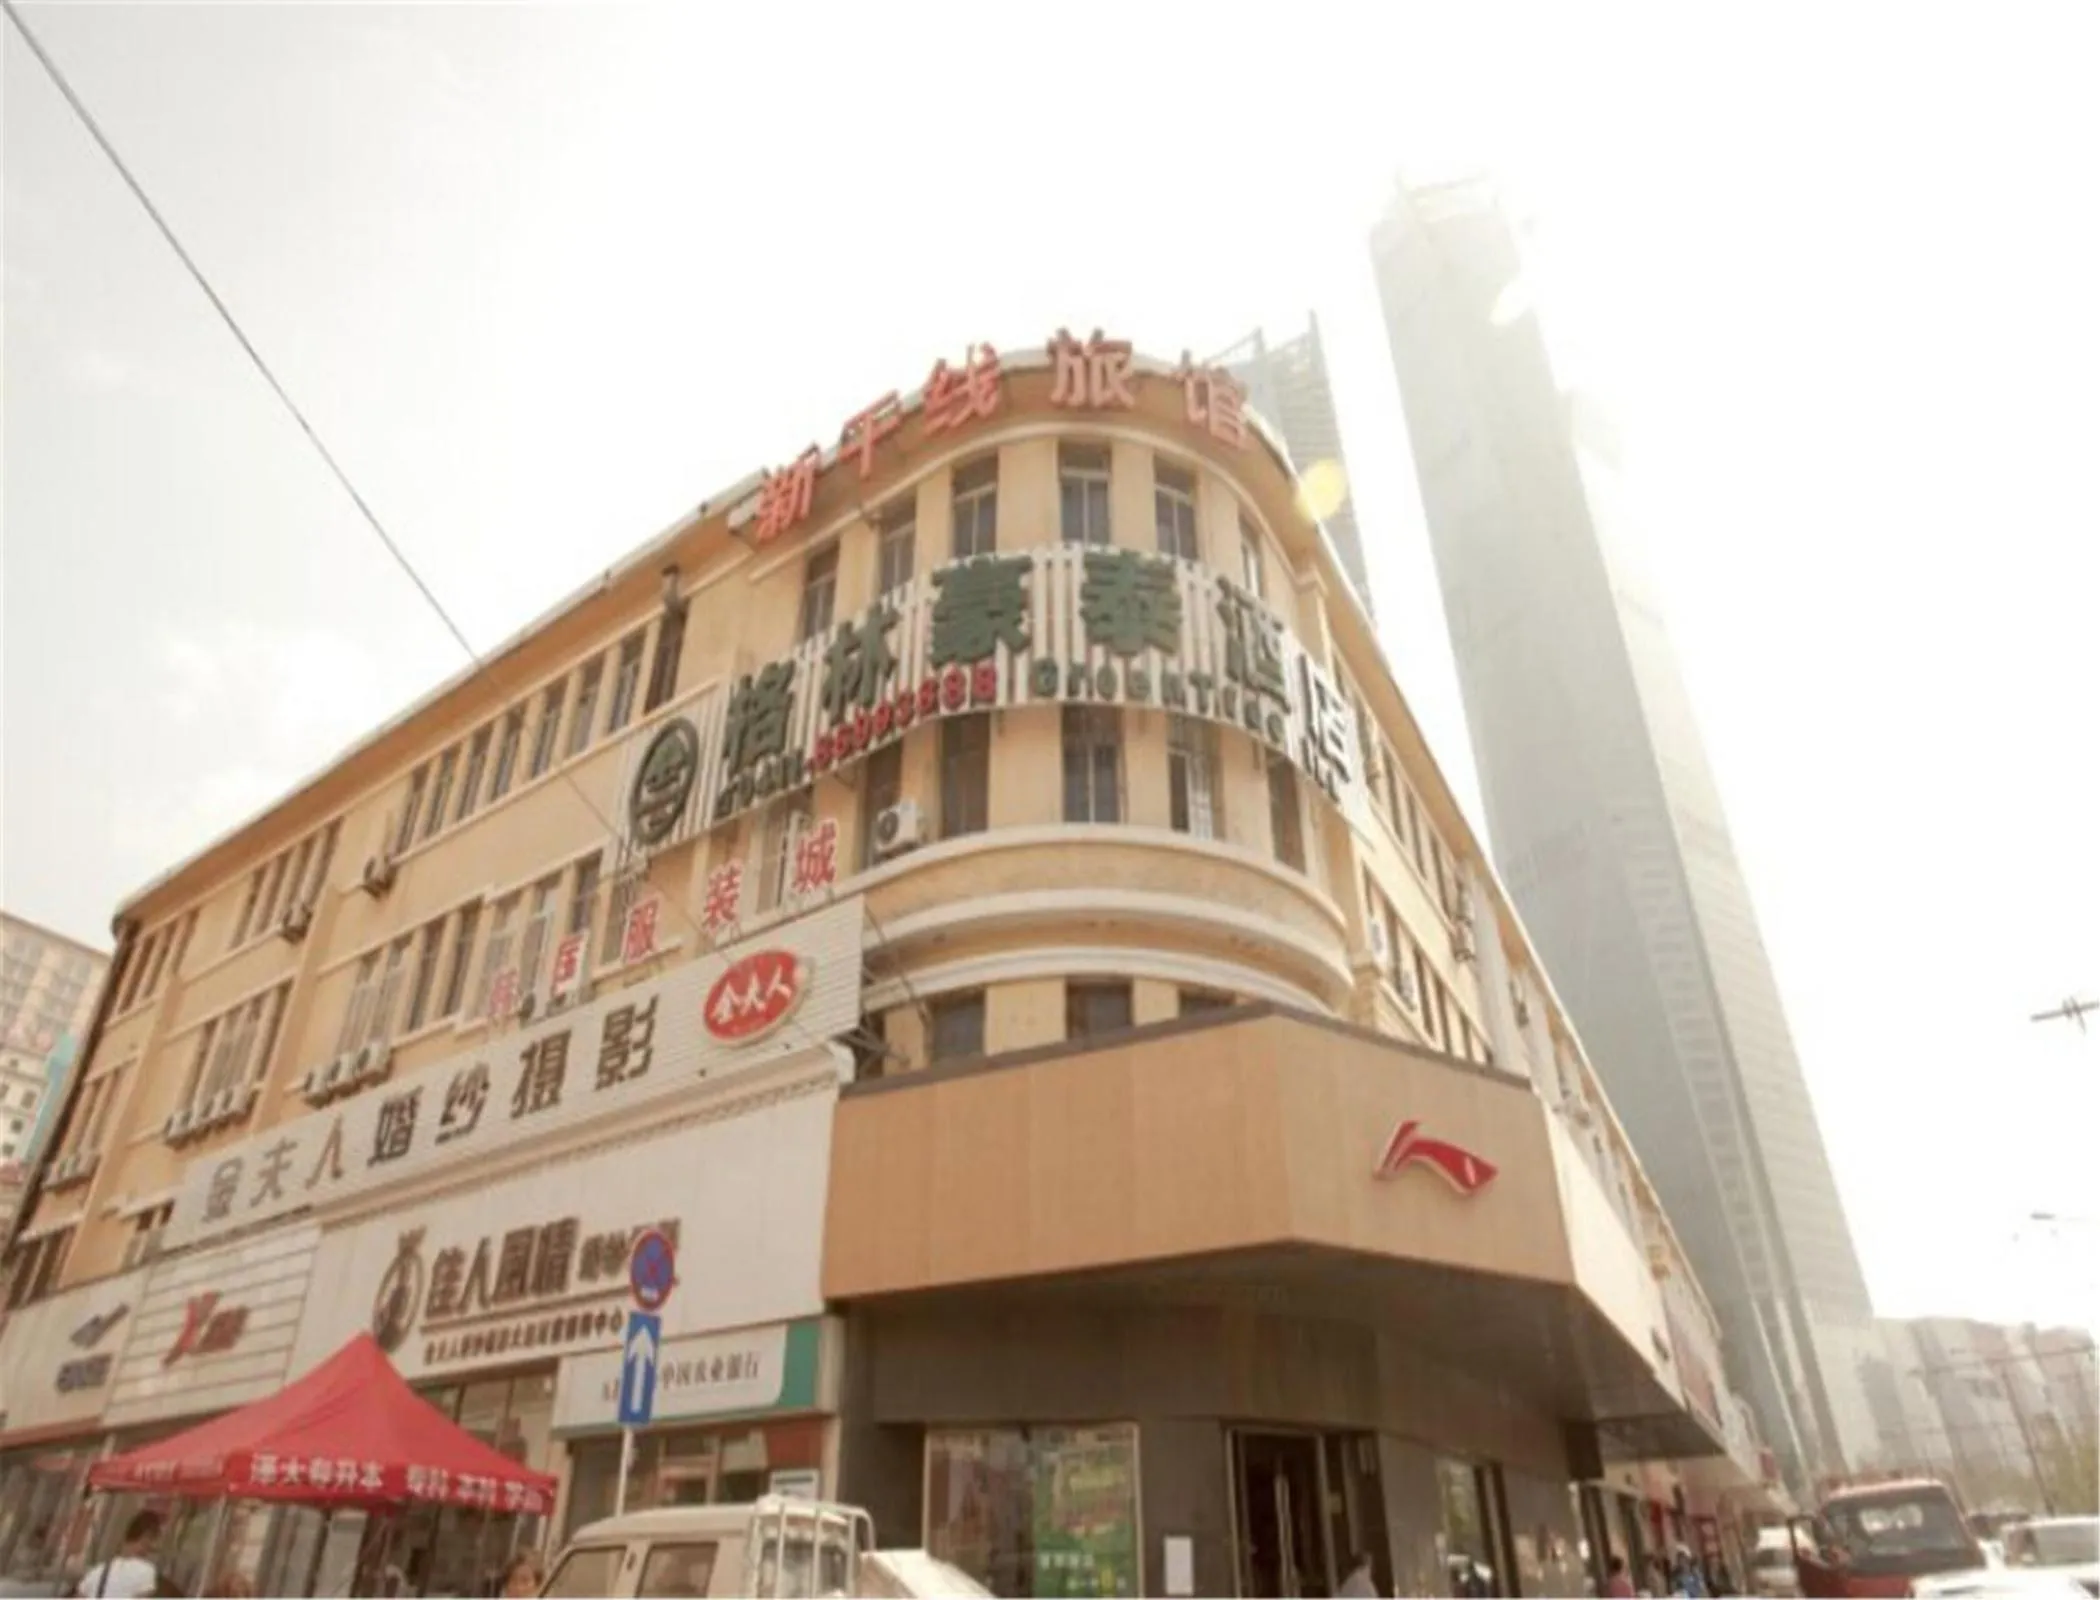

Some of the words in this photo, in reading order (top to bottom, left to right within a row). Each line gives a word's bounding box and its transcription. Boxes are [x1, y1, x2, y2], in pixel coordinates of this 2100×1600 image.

[722, 549, 1353, 792] 格林豪泰酒店
